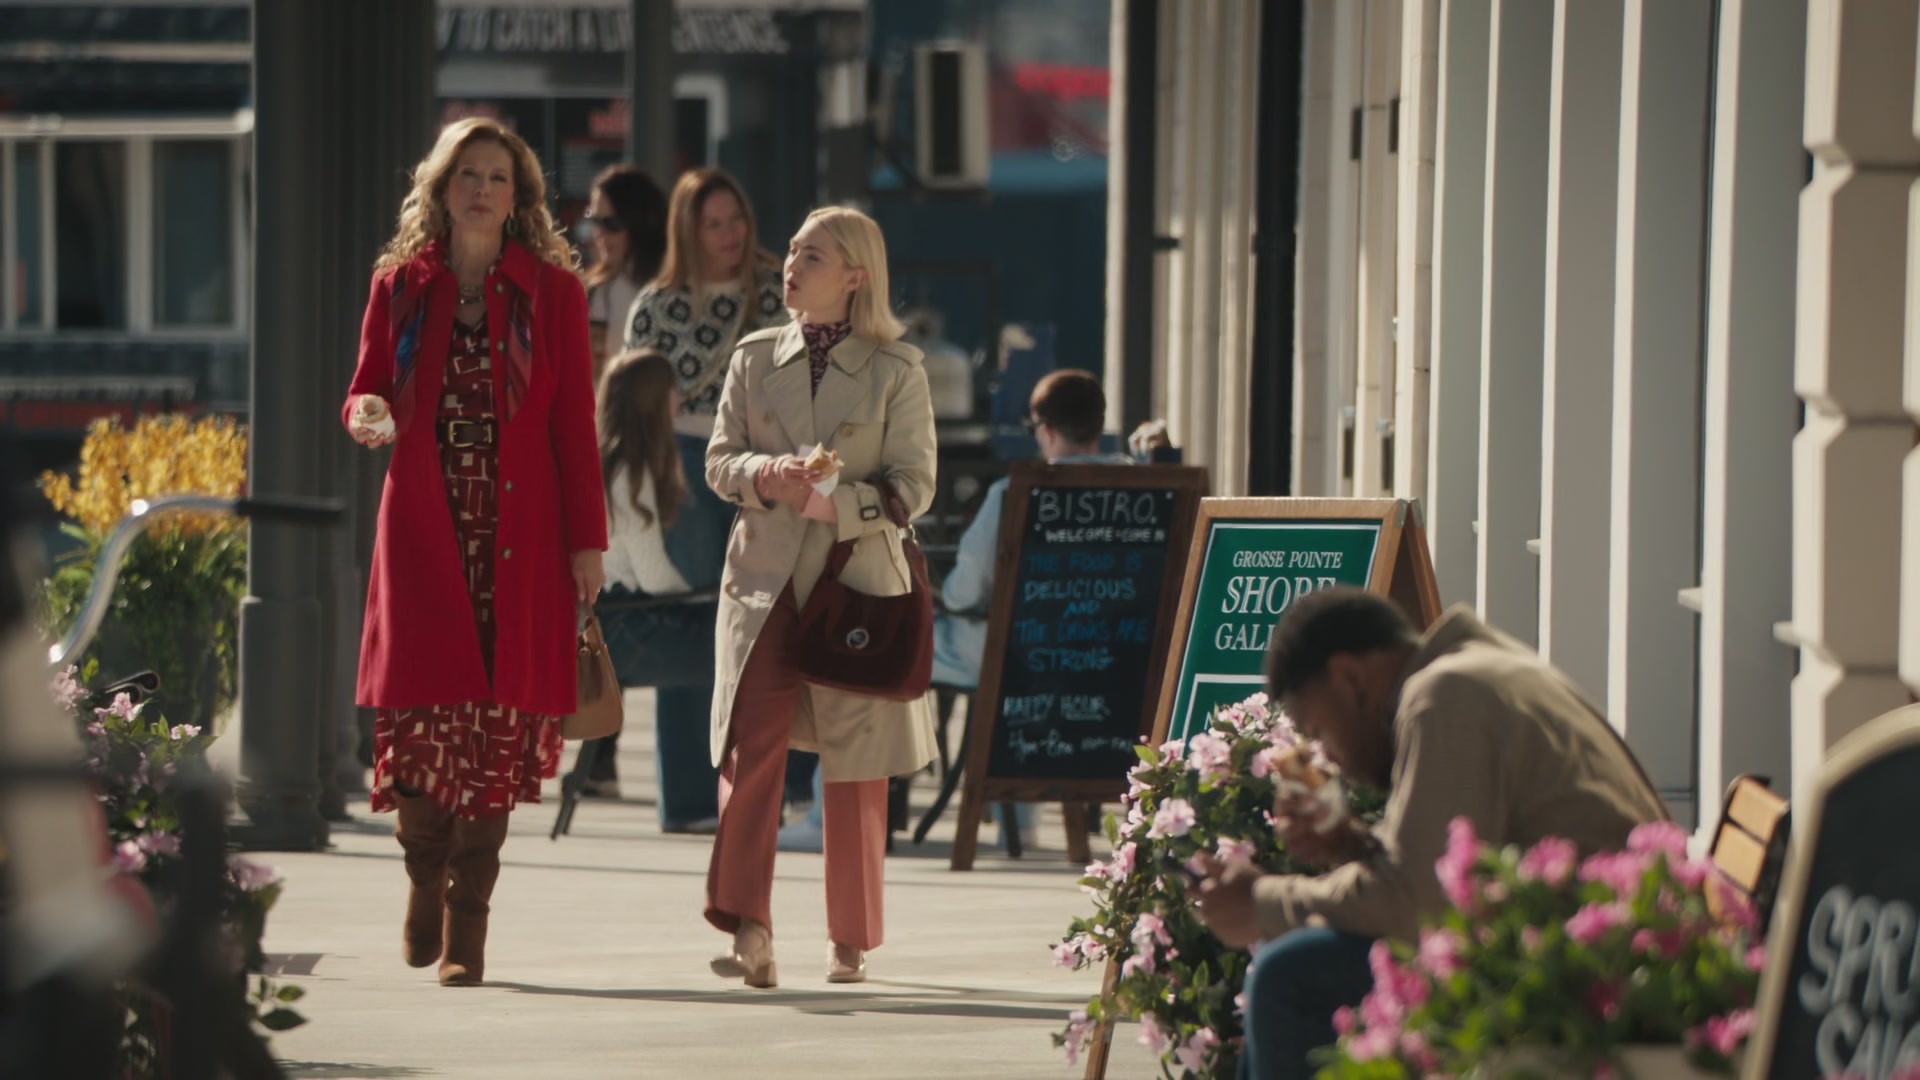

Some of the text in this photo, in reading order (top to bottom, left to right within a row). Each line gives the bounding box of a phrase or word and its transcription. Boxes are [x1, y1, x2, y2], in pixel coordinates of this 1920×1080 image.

[1232, 550, 1344, 569] GROSSE POINTE
[1023, 576, 1137, 602] DELICIOUS
[1220, 575, 1337, 615] SHOR
[1026, 646, 1115, 673] STRONG
